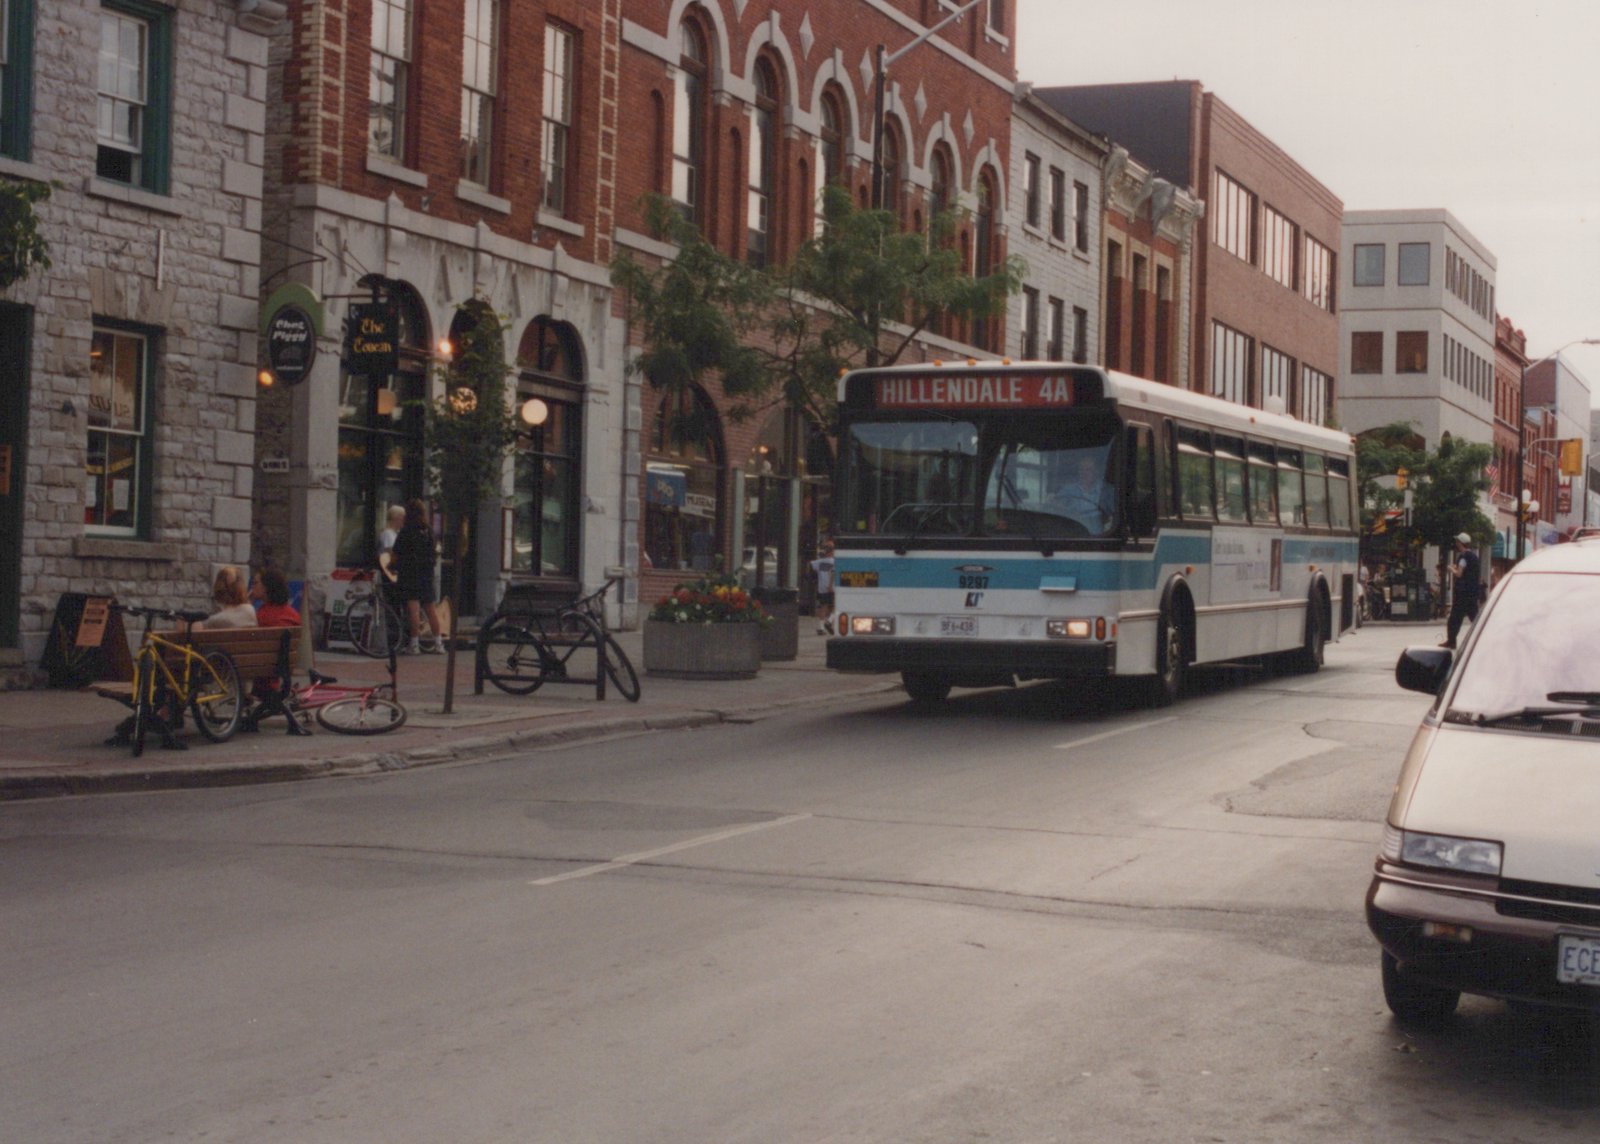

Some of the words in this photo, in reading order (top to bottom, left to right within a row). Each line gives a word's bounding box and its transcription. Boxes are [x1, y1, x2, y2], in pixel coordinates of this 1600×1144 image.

[276, 319, 305, 330] Chez
[362, 318, 384, 334] The
[882, 377, 1023, 403] HILLENDALE
[1039, 377, 1069, 402] 4A
[959, 575, 990, 589] 9297
[1563, 945, 1600, 974] ECE
